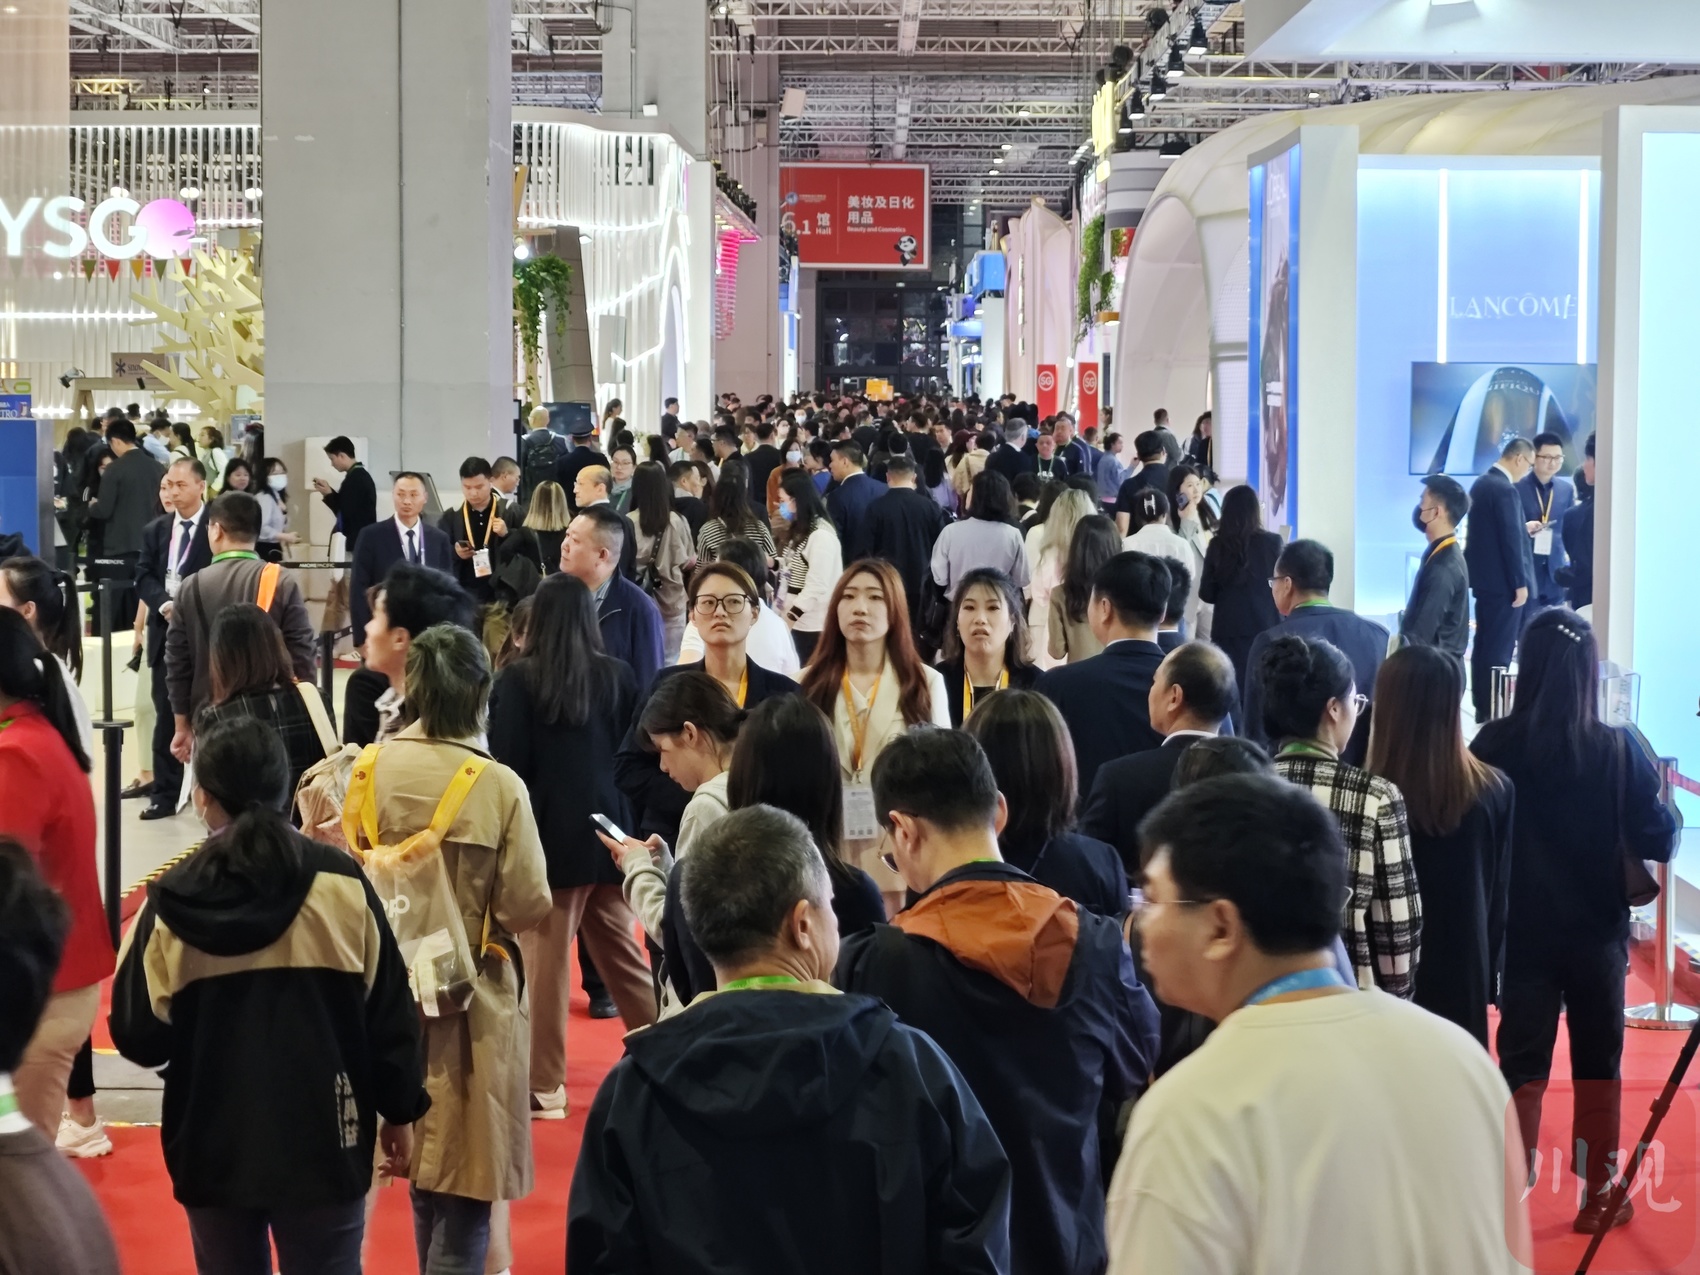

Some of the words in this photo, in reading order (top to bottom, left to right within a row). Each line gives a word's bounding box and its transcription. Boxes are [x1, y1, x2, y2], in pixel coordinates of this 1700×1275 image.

[847, 195, 915, 209] 美妆及日化
[781, 212, 811, 235] 6.1
[816, 212, 831, 226] 馆
[847, 211, 874, 224] 用品
[815, 227, 832, 235] Hall
[1040, 376, 1053, 386] SG
[1084, 377, 1096, 388] SG
